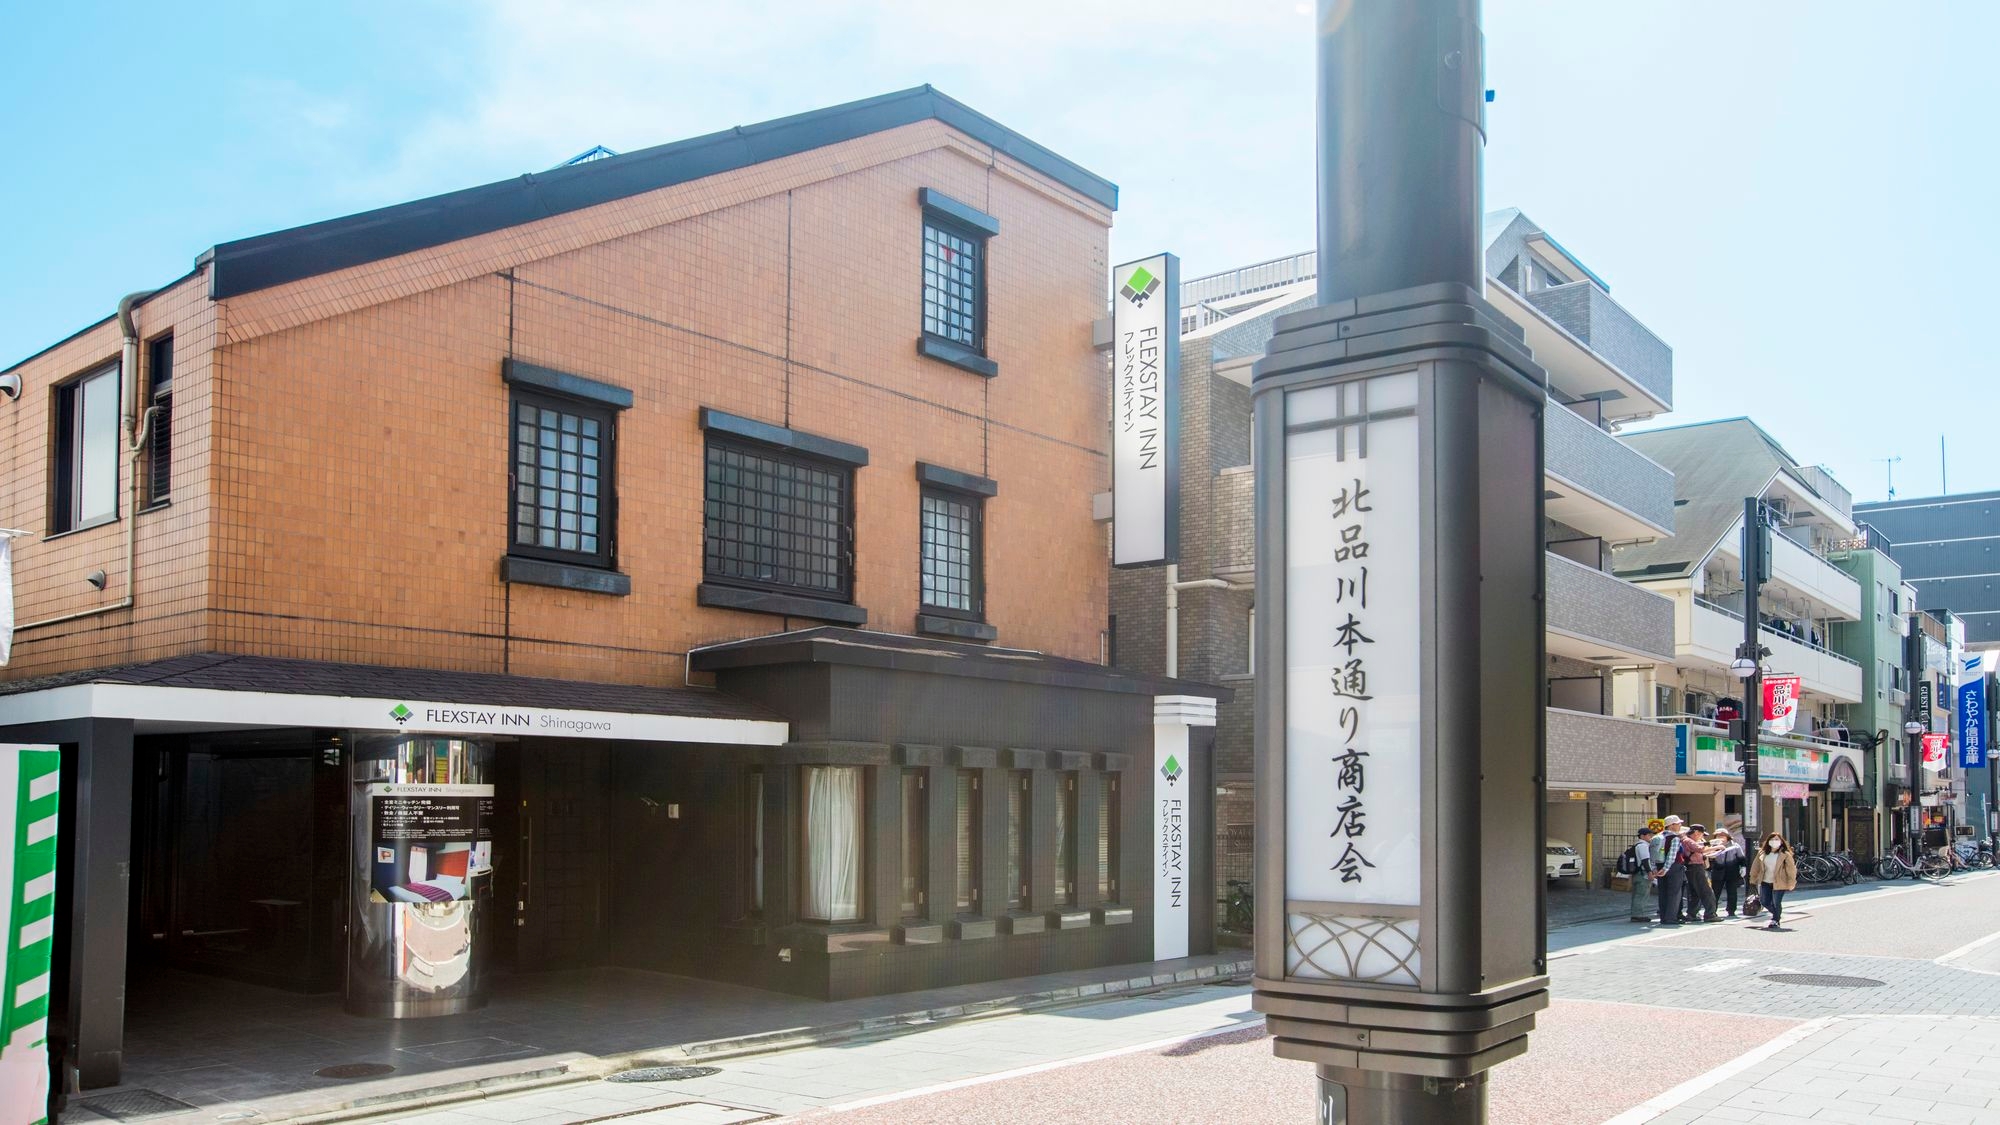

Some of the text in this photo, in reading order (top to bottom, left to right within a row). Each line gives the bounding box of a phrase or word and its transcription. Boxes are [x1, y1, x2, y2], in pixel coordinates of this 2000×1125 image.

[1123, 331, 1135, 433] フレックステイイン
[1139, 326, 1158, 471] FLEXSTAY INN
[426, 709, 611, 732] FLEXSTAY INN Shinagawa
[1330, 478, 1376, 884] 北品川本通り商店会
[1921, 686, 1929, 709] GUEST
[1965, 689, 1979, 765] さわやか信用金庫
[1171, 799, 1181, 908] FLEXSTAY INN
